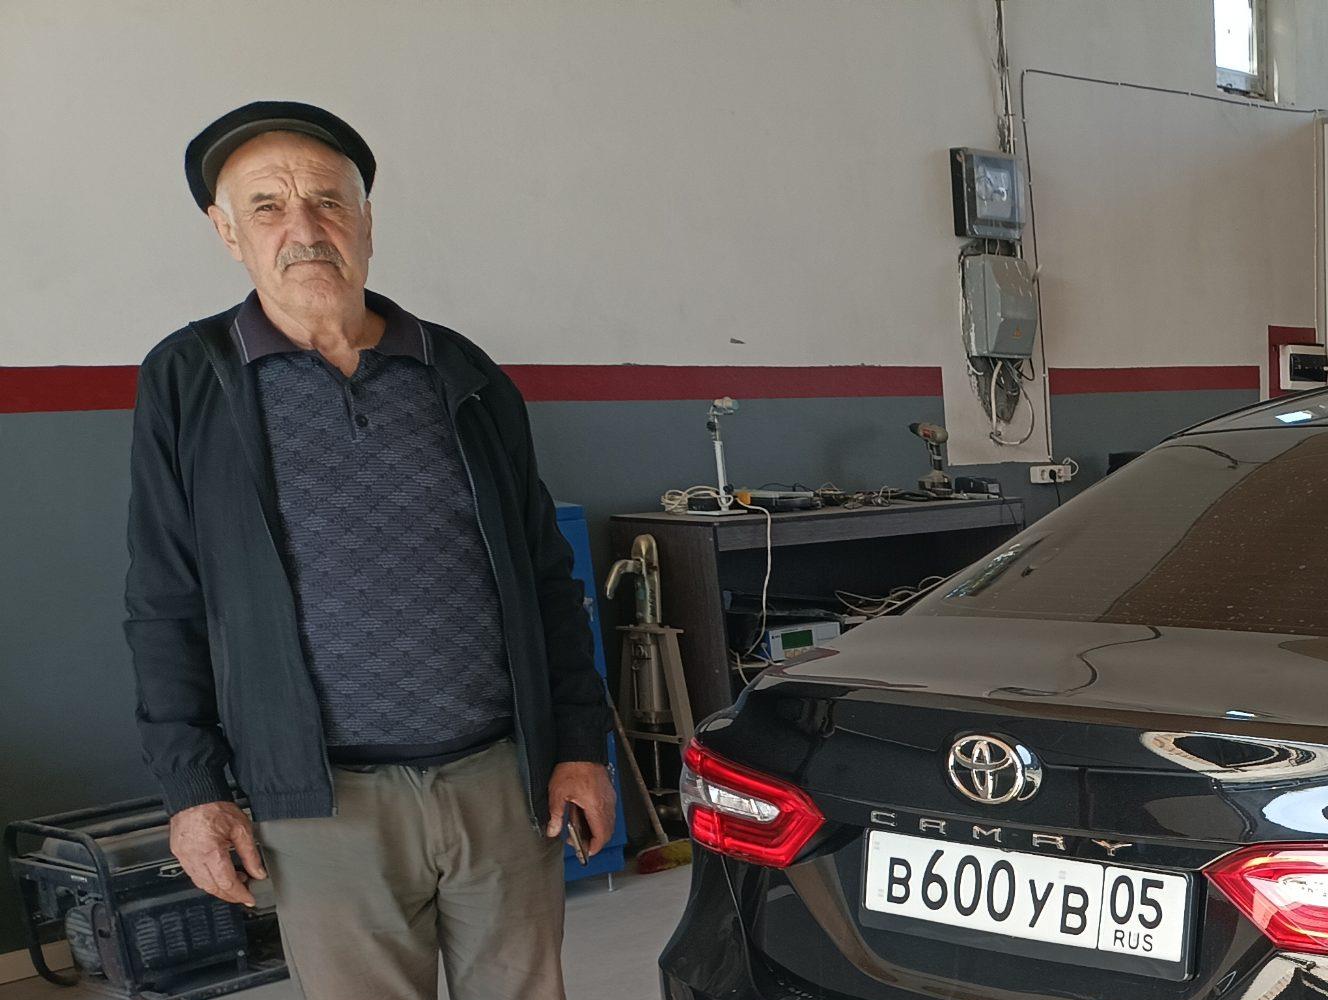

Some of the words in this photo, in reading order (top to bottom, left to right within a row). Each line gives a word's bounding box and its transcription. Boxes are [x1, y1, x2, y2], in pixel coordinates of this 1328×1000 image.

[870, 810, 1133, 857] CAMRY
[1109, 874, 1165, 930] 05
[1113, 929, 1154, 953] RUS
